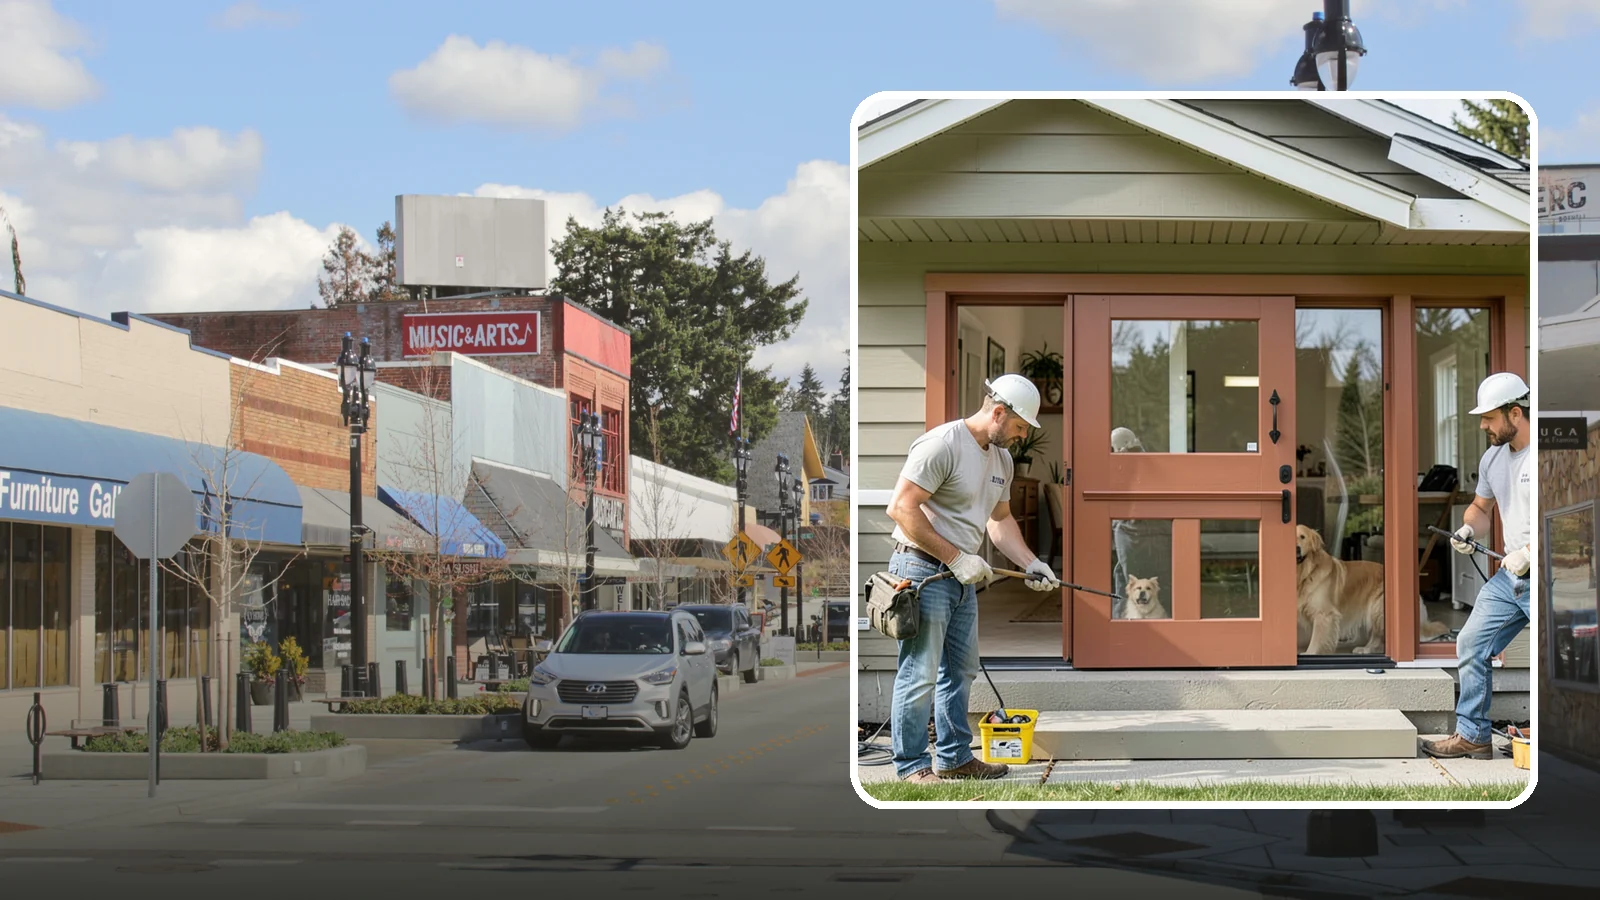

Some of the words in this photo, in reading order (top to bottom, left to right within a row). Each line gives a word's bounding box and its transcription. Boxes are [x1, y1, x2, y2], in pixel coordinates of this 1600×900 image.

[1540, 427, 1577, 437] UGA
[0, 472, 79, 515] Furniture
[89, 482, 121, 519] Gal
[453, 563, 479, 574] SUSHI
